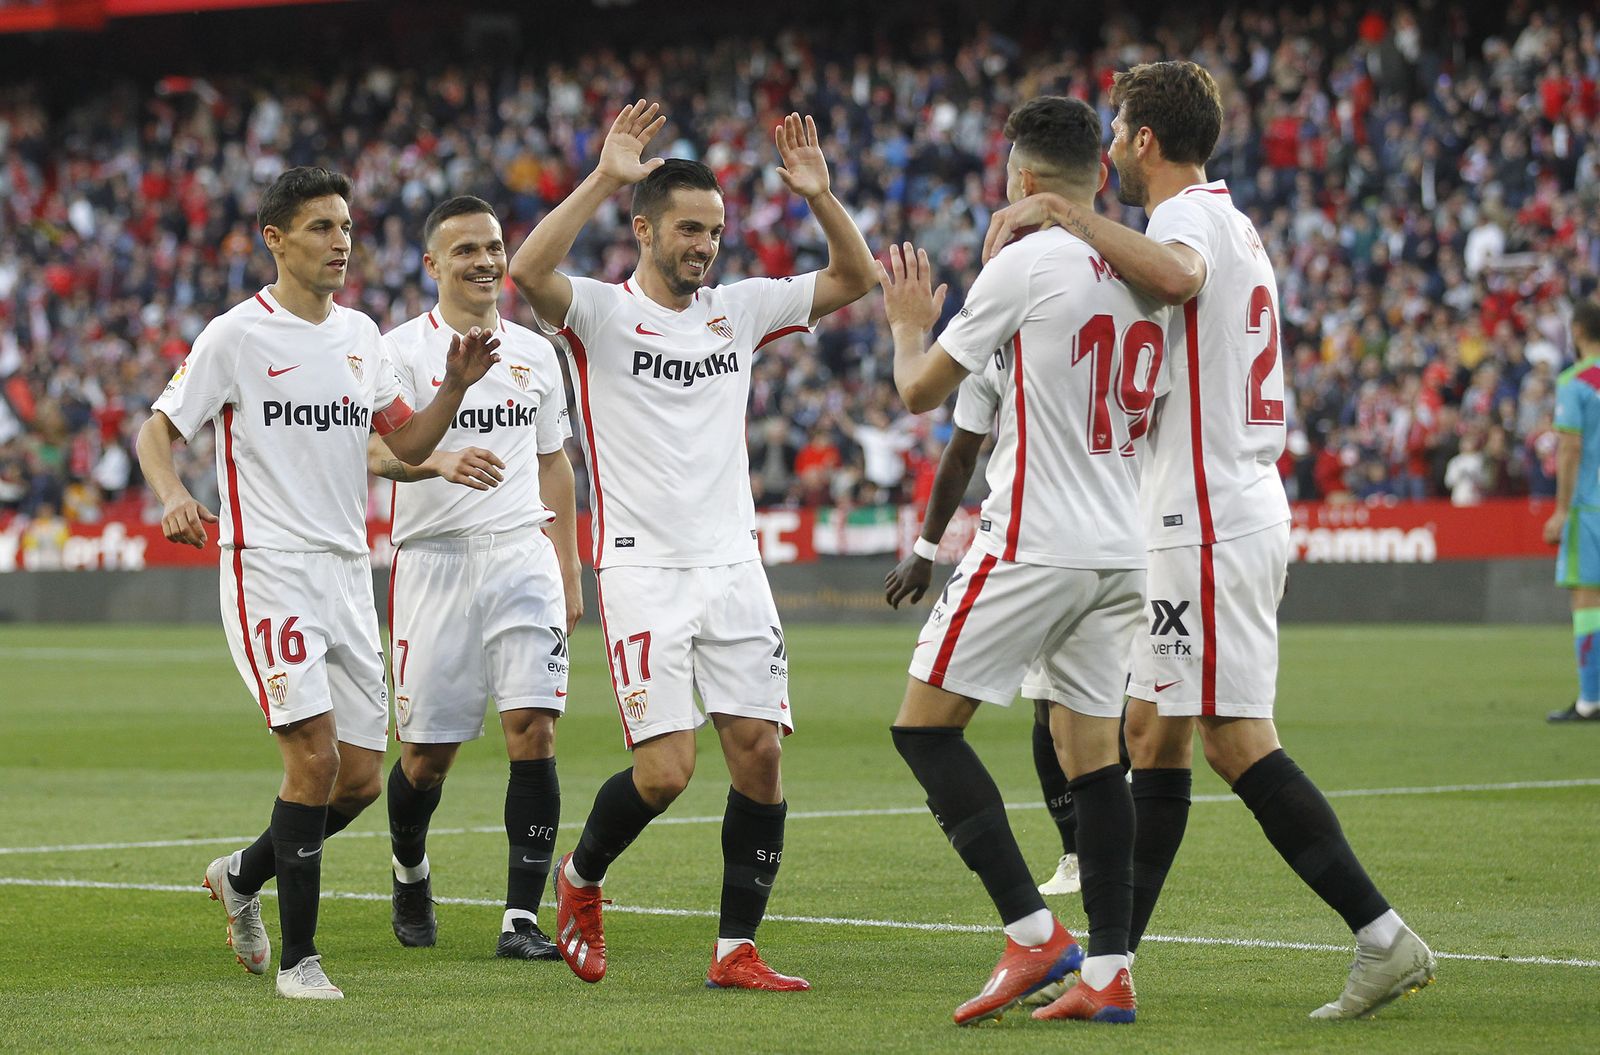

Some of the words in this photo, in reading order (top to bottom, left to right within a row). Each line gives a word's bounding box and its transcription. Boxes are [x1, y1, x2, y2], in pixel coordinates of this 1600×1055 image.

[1072, 314, 1164, 457] 19
[263, 395, 369, 432] Playtika
[451, 399, 538, 433] laytika
[254, 616, 307, 668] 16
[613, 630, 652, 688] 17
[1152, 640, 1191, 655] verfx
[397, 639, 409, 687] 7
[1050, 791, 1072, 808] SFC
[528, 825, 553, 841] SFC
[756, 849, 783, 864] SFC
